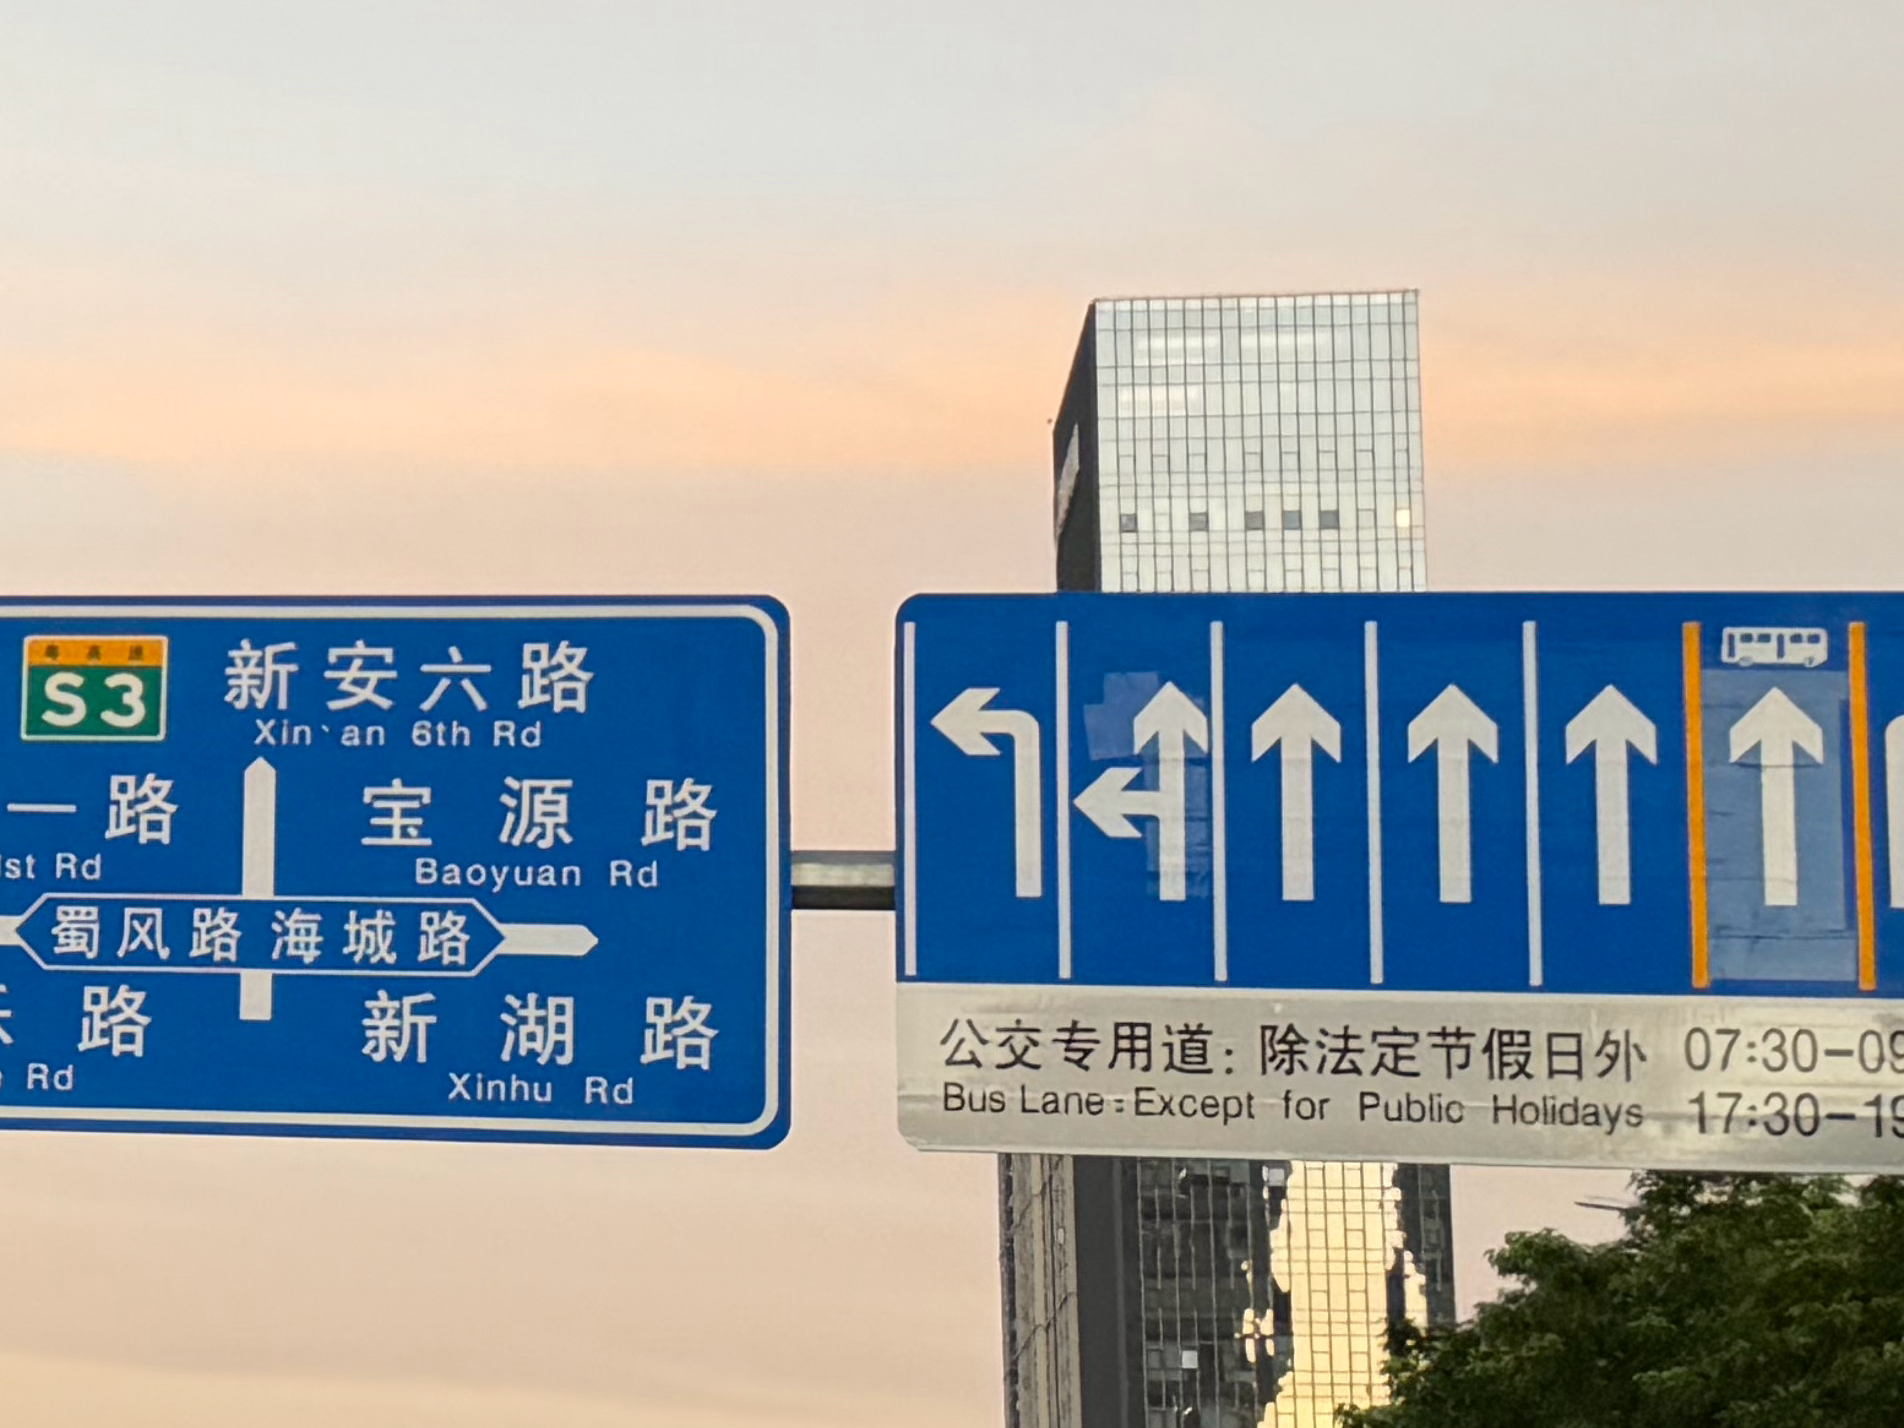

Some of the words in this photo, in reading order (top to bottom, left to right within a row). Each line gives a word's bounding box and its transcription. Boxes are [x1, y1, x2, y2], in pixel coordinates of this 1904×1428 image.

[41, 671, 147, 728] S3
[224, 638, 594, 714] 新安六路
[412, 720, 471, 747] 6th
[493, 720, 542, 748] Rd
[361, 776, 718, 852] 宝源路
[54, 852, 102, 880] Rd
[415, 857, 582, 893] Baoyuan
[609, 859, 659, 889] Rd
[271, 907, 472, 967] 海城路
[362, 989, 720, 1072] 新湖路
[26, 1062, 74, 1091] Rd
[448, 1073, 553, 1104] Xinhu
[584, 1075, 634, 1106] Rd
[943, 1082, 1006, 1114] Bus
[1134, 1086, 1256, 1125] Except
[1282, 1089, 1329, 1123] for
[1358, 1091, 1465, 1125] Public
[1492, 1093, 1645, 1130] Holidays
